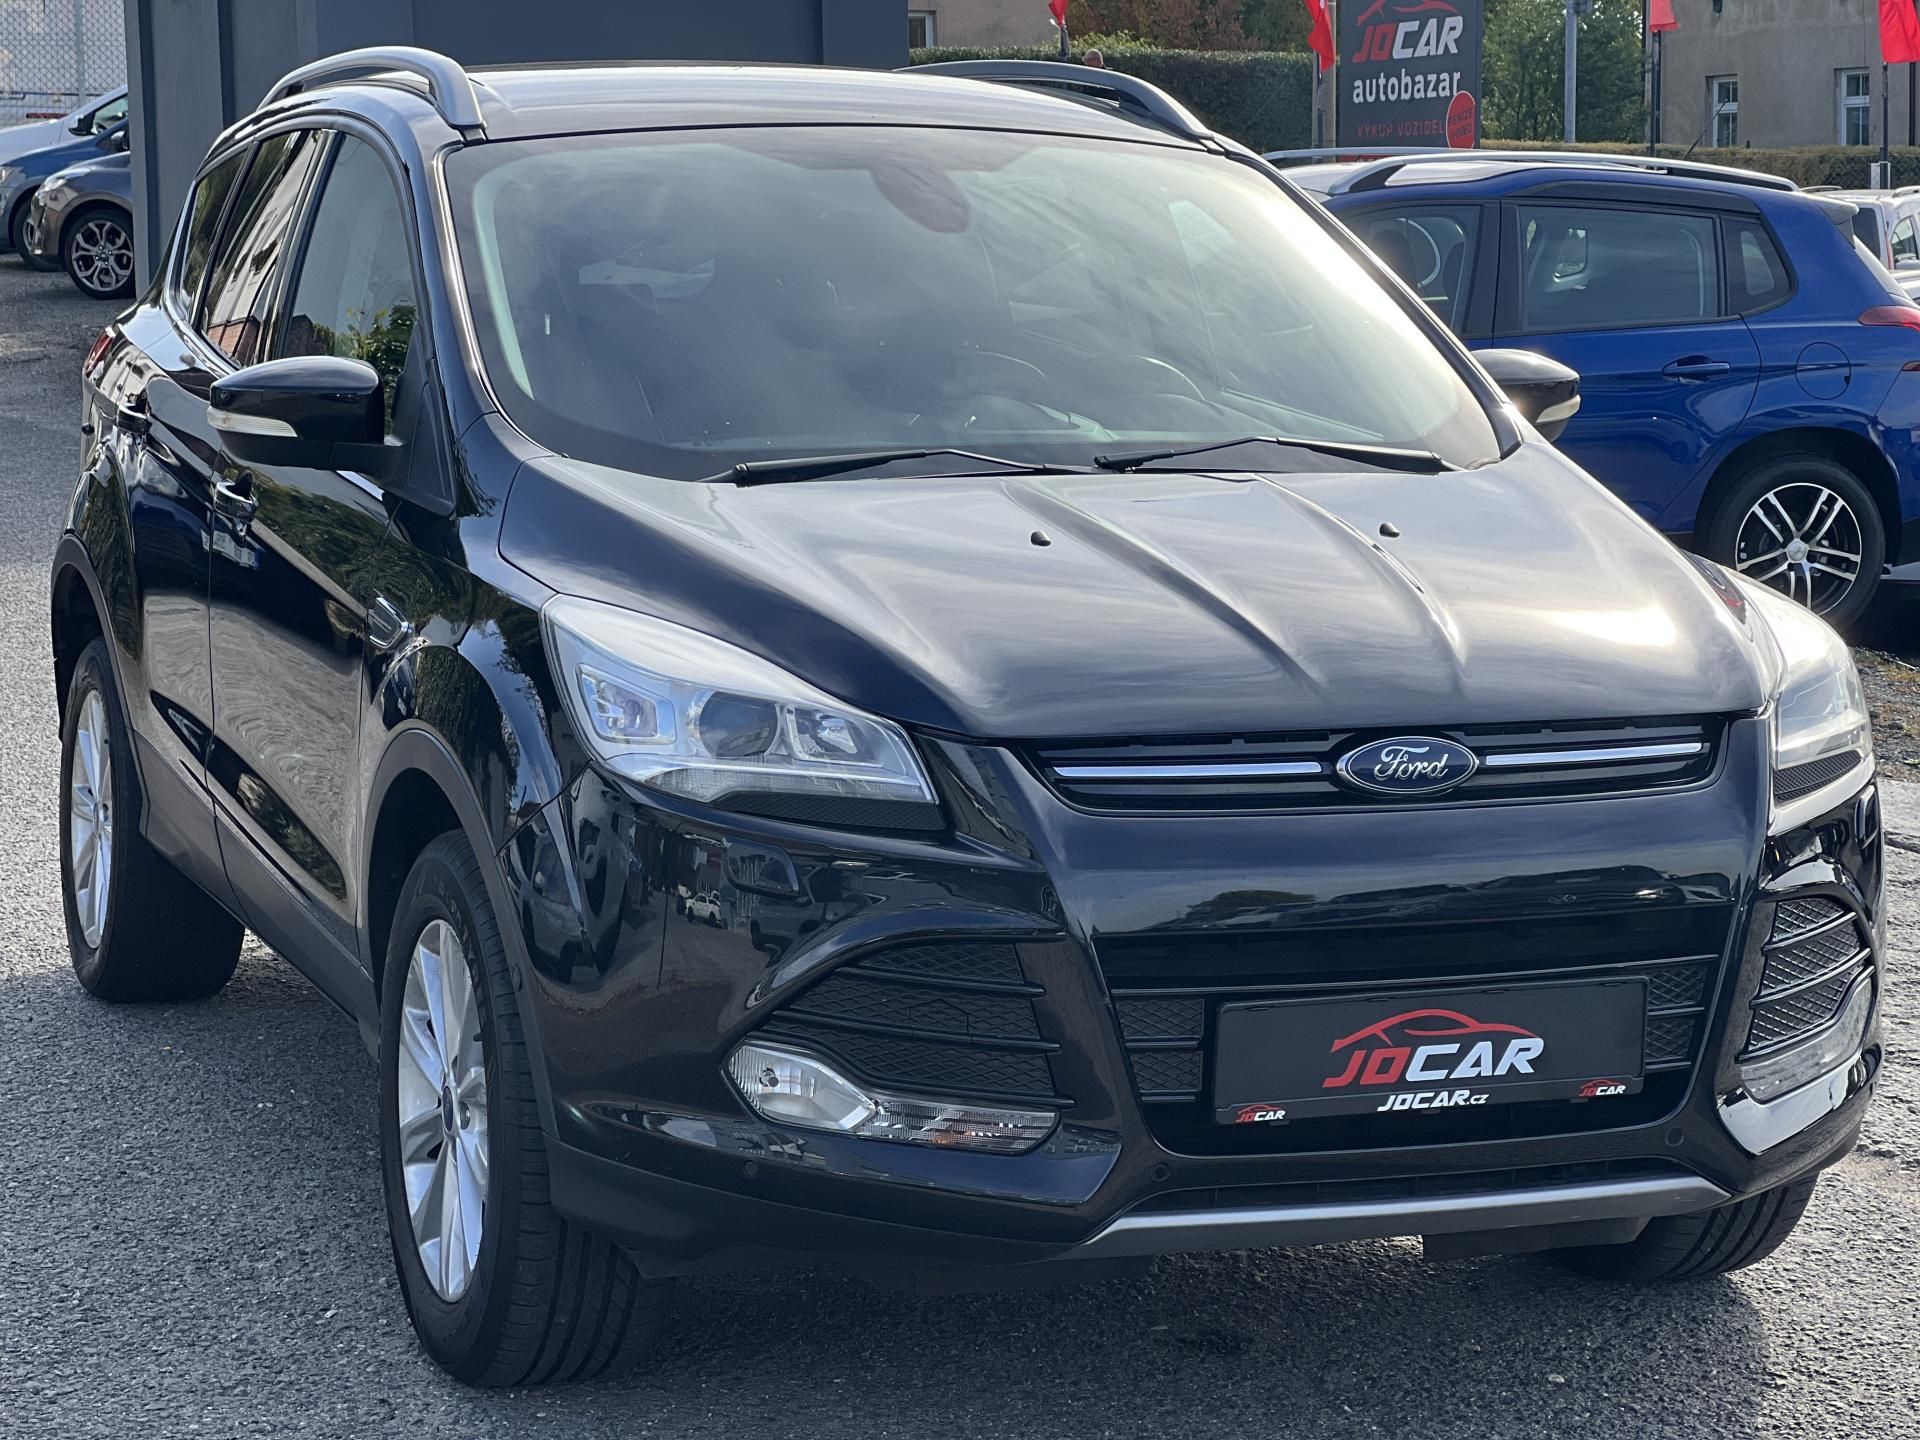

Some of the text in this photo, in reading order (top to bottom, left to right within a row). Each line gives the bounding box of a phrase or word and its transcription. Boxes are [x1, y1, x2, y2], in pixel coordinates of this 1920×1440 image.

[1352, 16, 1463, 63] JOCAR
[1353, 68, 1461, 103] autobazar
[1398, 119, 1444, 136] VOZIDEL
[1374, 745, 1449, 781] Ford
[1322, 1037, 1544, 1088] JOCAR
[1377, 1089, 1490, 1112] JOCAR.cz
[1578, 1085, 1627, 1097] JOCAR
[1235, 1110, 1286, 1123] JOCAR
